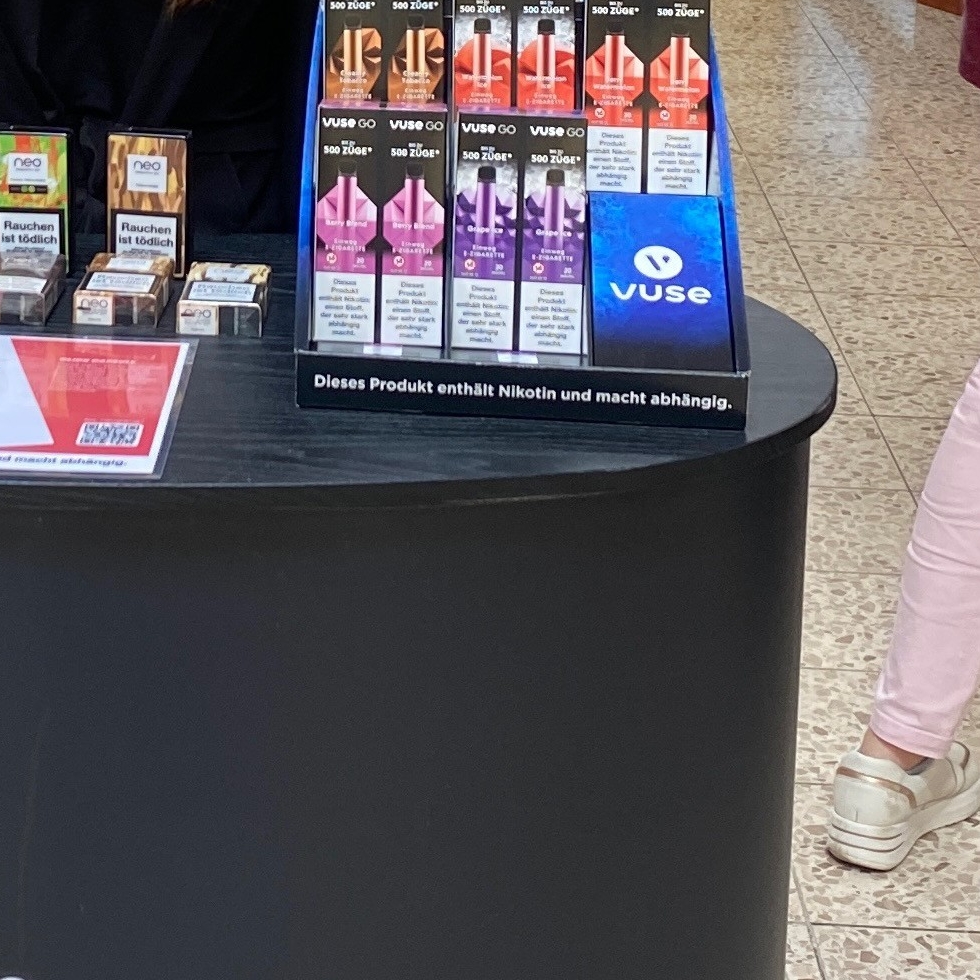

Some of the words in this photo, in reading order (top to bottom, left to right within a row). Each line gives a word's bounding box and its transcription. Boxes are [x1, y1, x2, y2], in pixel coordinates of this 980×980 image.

[330, 1, 346, 10] 500
[392, 1, 408, 10] 500
[459, 5, 475, 14] 500
[523, 5, 539, 14] 500
[591, 6, 608, 15] 500
[657, 8, 673, 17] 500
[357, 118, 377, 129] GO
[425, 120, 444, 131] GO
[497, 124, 517, 135] GO
[566, 127, 585, 138] GO
[323, 145, 340, 154] 500
[390, 147, 408, 157] 500
[462, 150, 480, 160] 500
[13, 156, 42, 167] neo
[531, 154, 548, 164] 500
[133, 160, 161, 171] neo
[3, 220, 55, 232] Rauchen
[121, 222, 172, 235] Rauchen
[1, 233, 16, 243] ist
[18, 233, 58, 244] tödlich
[118, 234, 132, 244] ist
[135, 234, 174, 248] tödlich
[314, 373, 366, 390] Dieses
[370, 376, 433, 394] Produkt
[437, 381, 495, 397] enthält
[498, 385, 557, 400] Nikotin
[560, 388, 592, 402] und
[596, 390, 646, 406] macht
[650, 392, 733, 410] abhängig.
